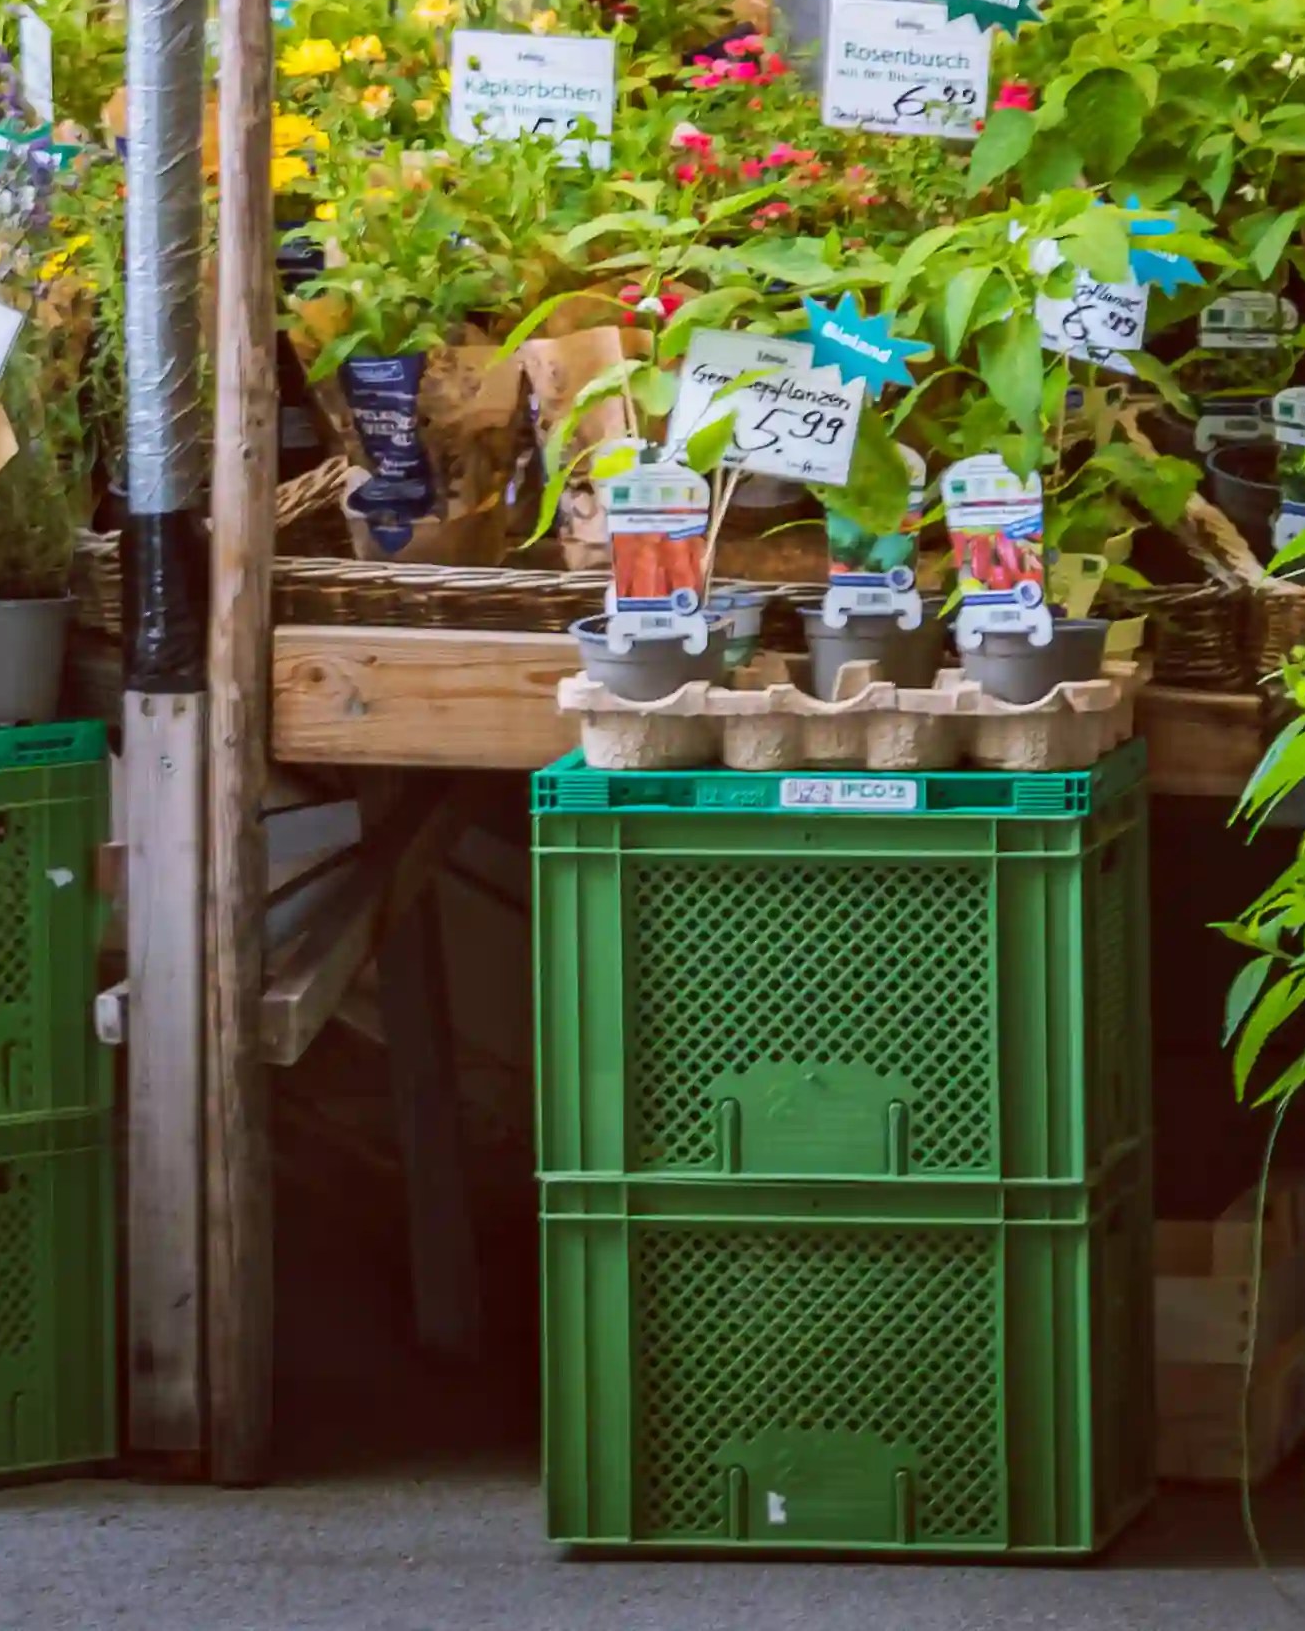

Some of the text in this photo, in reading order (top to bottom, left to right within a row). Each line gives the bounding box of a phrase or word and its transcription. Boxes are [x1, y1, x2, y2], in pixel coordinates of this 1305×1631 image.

[844, 41, 971, 70] Rosenbusch
[692, 363, 851, 411] Gemepflanzen
[733, 408, 847, 454] 5.99
